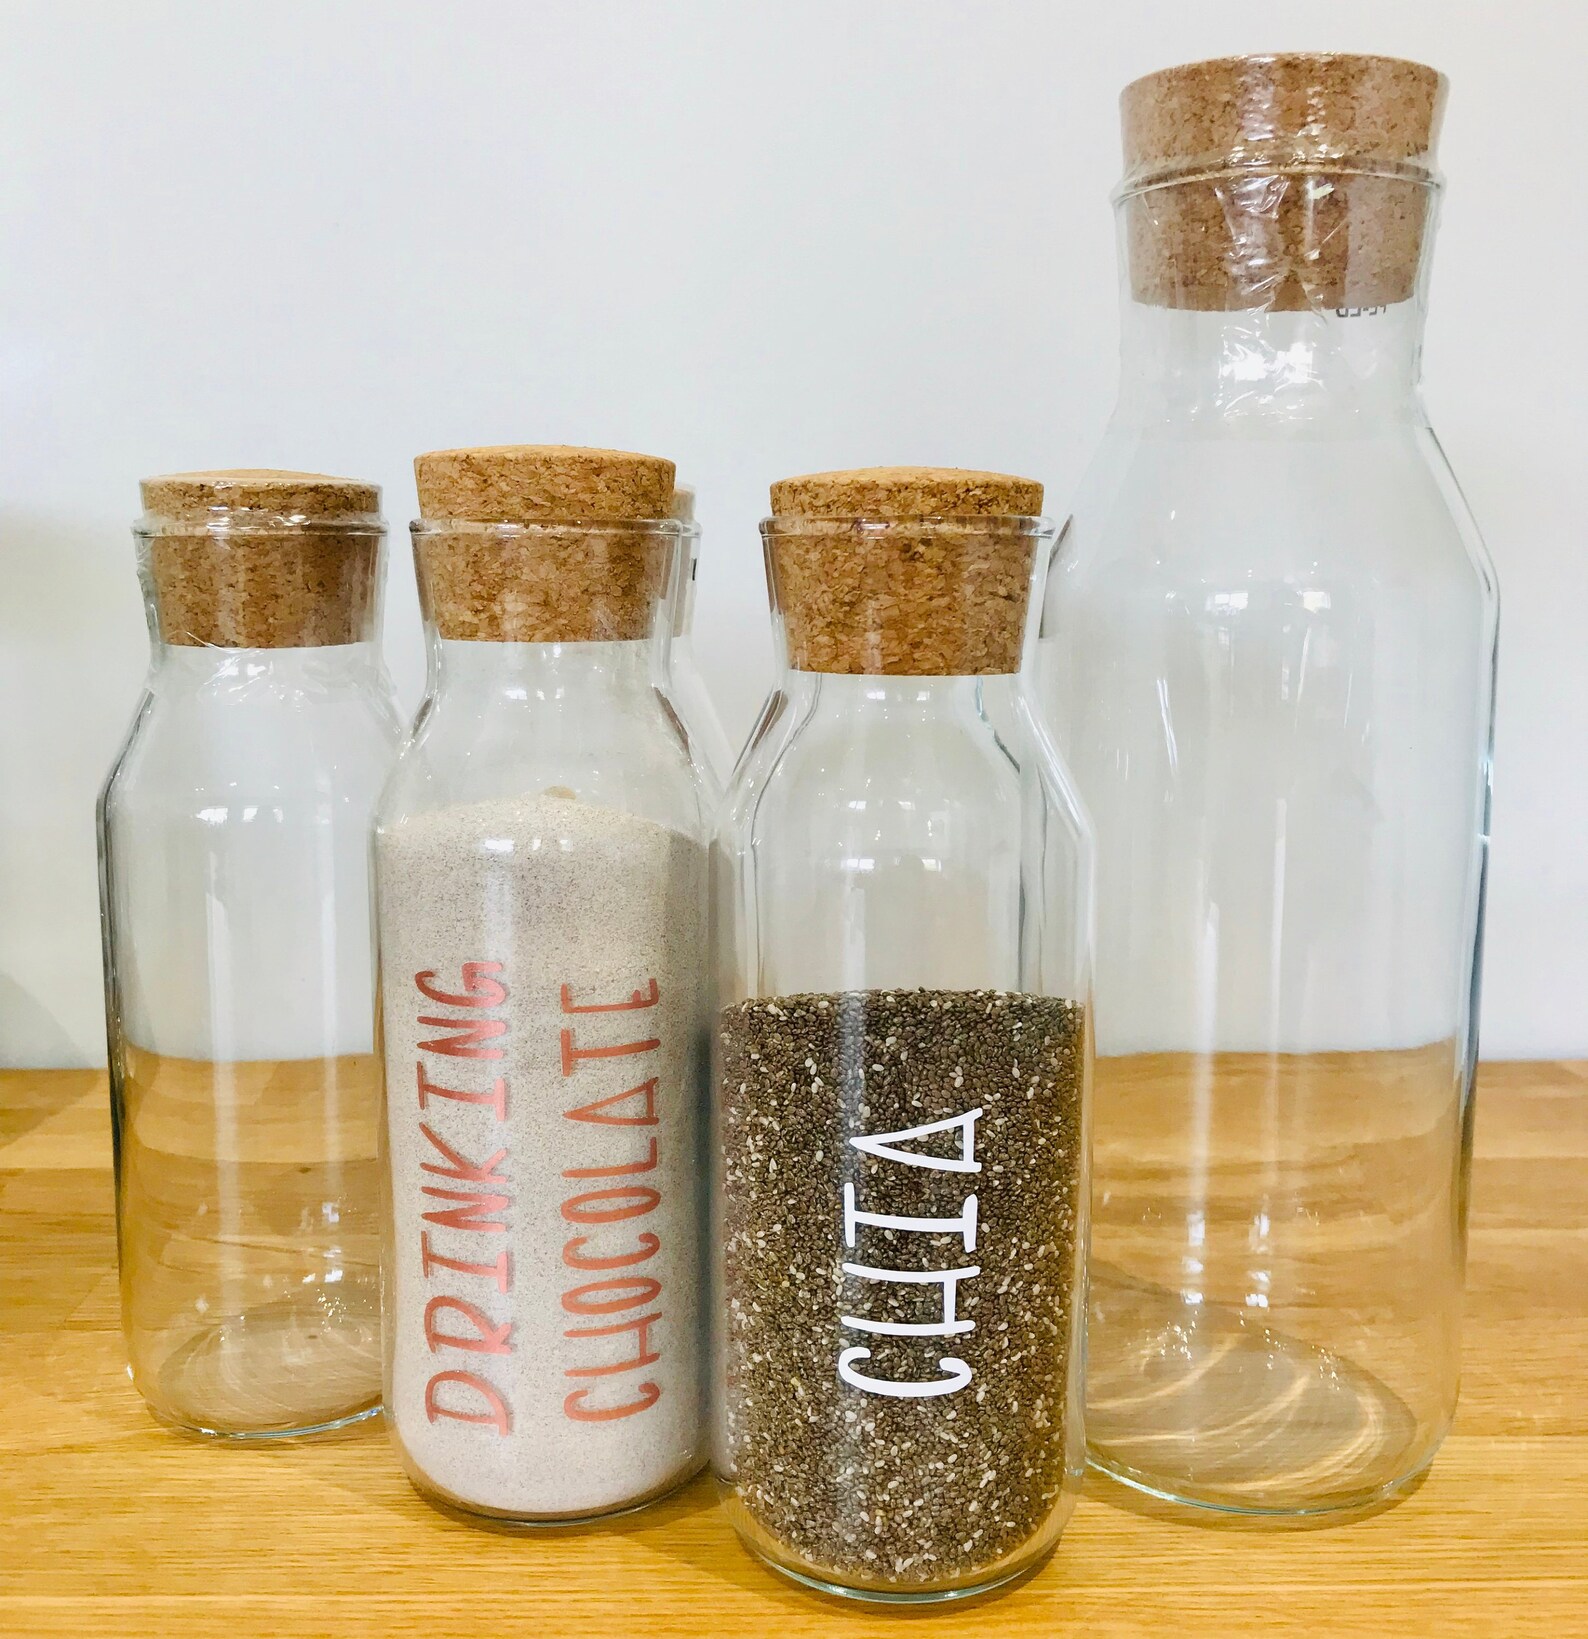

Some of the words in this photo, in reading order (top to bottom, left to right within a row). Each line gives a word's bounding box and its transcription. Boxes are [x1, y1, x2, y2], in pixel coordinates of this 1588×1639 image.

[415, 961, 512, 1436] DRINKING
[560, 978, 662, 1421] CHOCOLATE
[838, 1107, 982, 1397] CHIA
